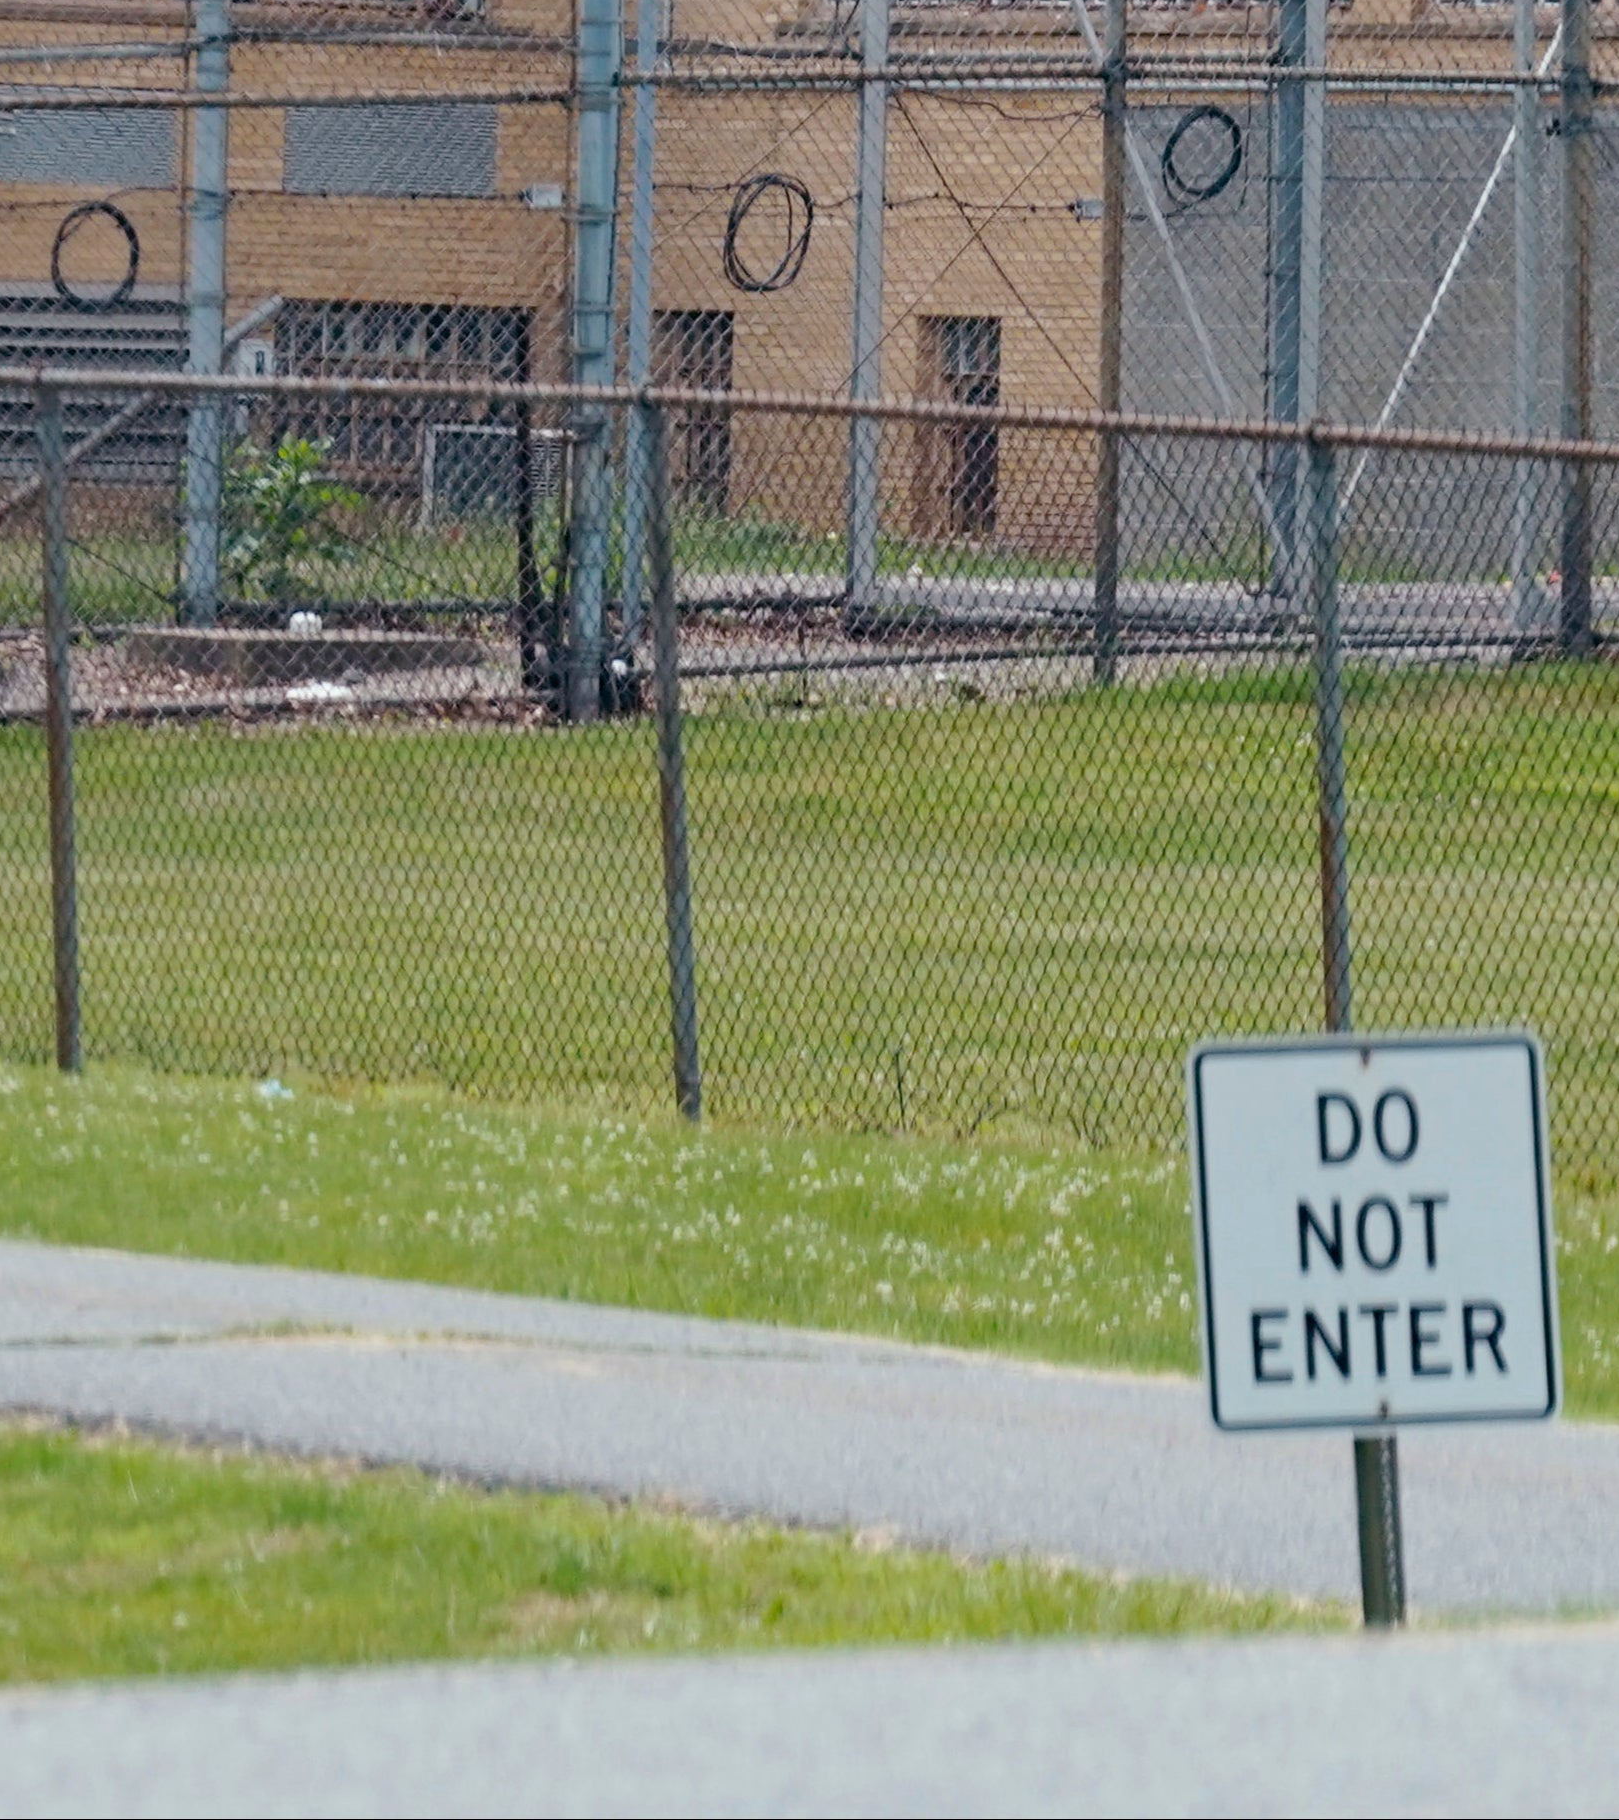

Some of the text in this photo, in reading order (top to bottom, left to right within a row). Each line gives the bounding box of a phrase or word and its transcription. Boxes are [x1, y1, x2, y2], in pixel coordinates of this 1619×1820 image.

[1316, 1085, 1420, 1165] DO
[1296, 1192, 1449, 1272] NOT
[1250, 1299, 1509, 1385] ENTER
